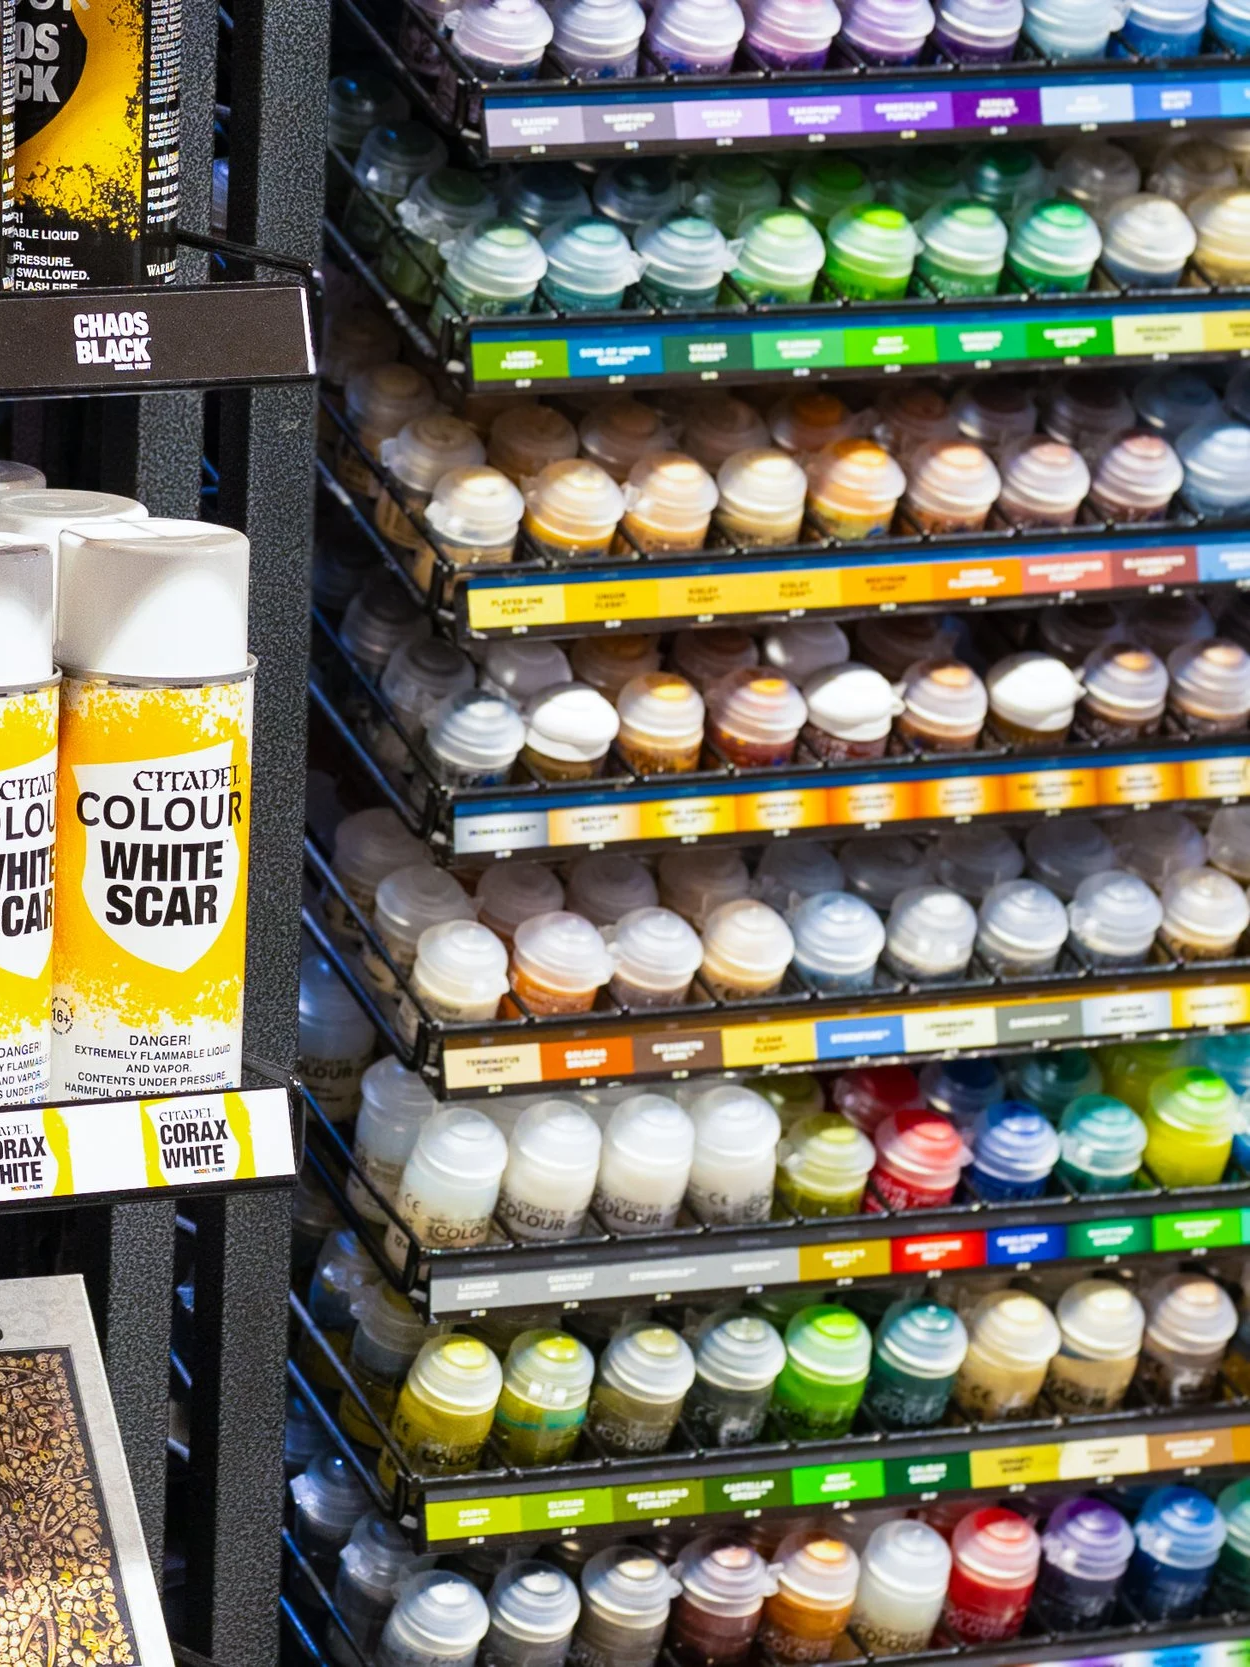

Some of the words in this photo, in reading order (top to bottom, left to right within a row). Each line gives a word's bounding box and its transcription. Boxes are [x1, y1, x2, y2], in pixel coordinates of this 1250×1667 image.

[42, 230, 80, 241] LIQUID
[16, 267, 90, 280] SWALLOWED.
[74, 311, 149, 338] CHAOS
[75, 338, 151, 364] BLACK
[133, 764, 241, 792] CITADEL
[76, 791, 242, 832] COLOUR
[100, 840, 224, 882] WHITE
[105, 884, 218, 927] SCAR
[52, 1007, 70, 1024] 16+
[129, 1035, 191, 1046] DANGER!
[75, 1045, 137, 1060] EXTREMELY
[140, 1049, 204, 1060] FLAMMABLE
[207, 1043, 231, 1057] LIQUID
[126, 1064, 150, 1074] AND
[154, 1064, 192, 1073] VAPOR.
[78, 1072, 135, 1086] CONTENTS
[139, 1077, 177, 1087] UNDER
[6, 1086, 34, 1099] UNDER
[64, 1082, 112, 1098] HARMFUL
[159, 1108, 214, 1123] CITADEL
[160, 1119, 228, 1145] CORAX
[162, 1144, 225, 1169] WHITE
